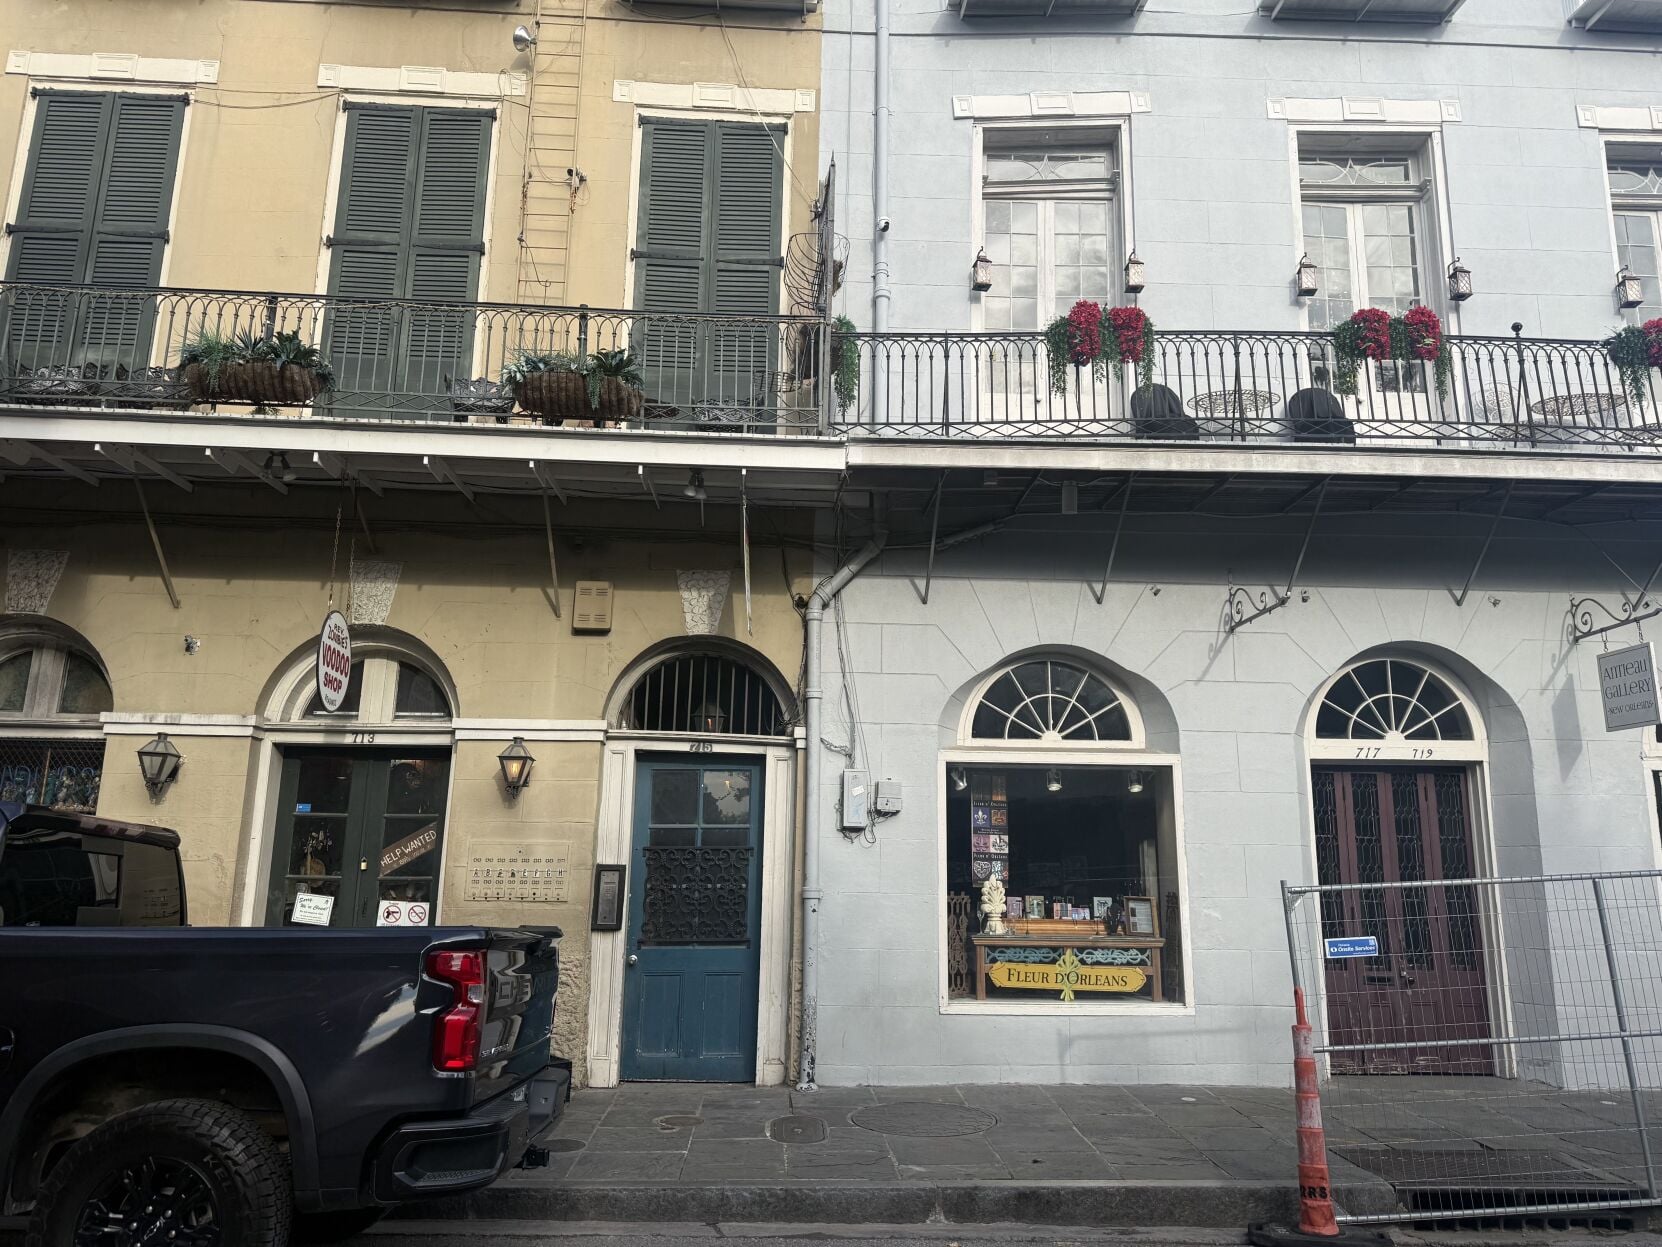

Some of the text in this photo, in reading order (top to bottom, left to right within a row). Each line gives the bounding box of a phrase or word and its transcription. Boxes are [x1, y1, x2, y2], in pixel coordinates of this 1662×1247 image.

[322, 641, 349, 678] VOODOO
[323, 671, 343, 694] SHOP
[351, 733, 375, 744] 713
[690, 742, 711, 752] 715
[1355, 747, 1433, 759] 717 719
[380, 848, 401, 867] HELP
[402, 830, 437, 854] WANTED
[1006, 967, 1050, 983] FLEUR
